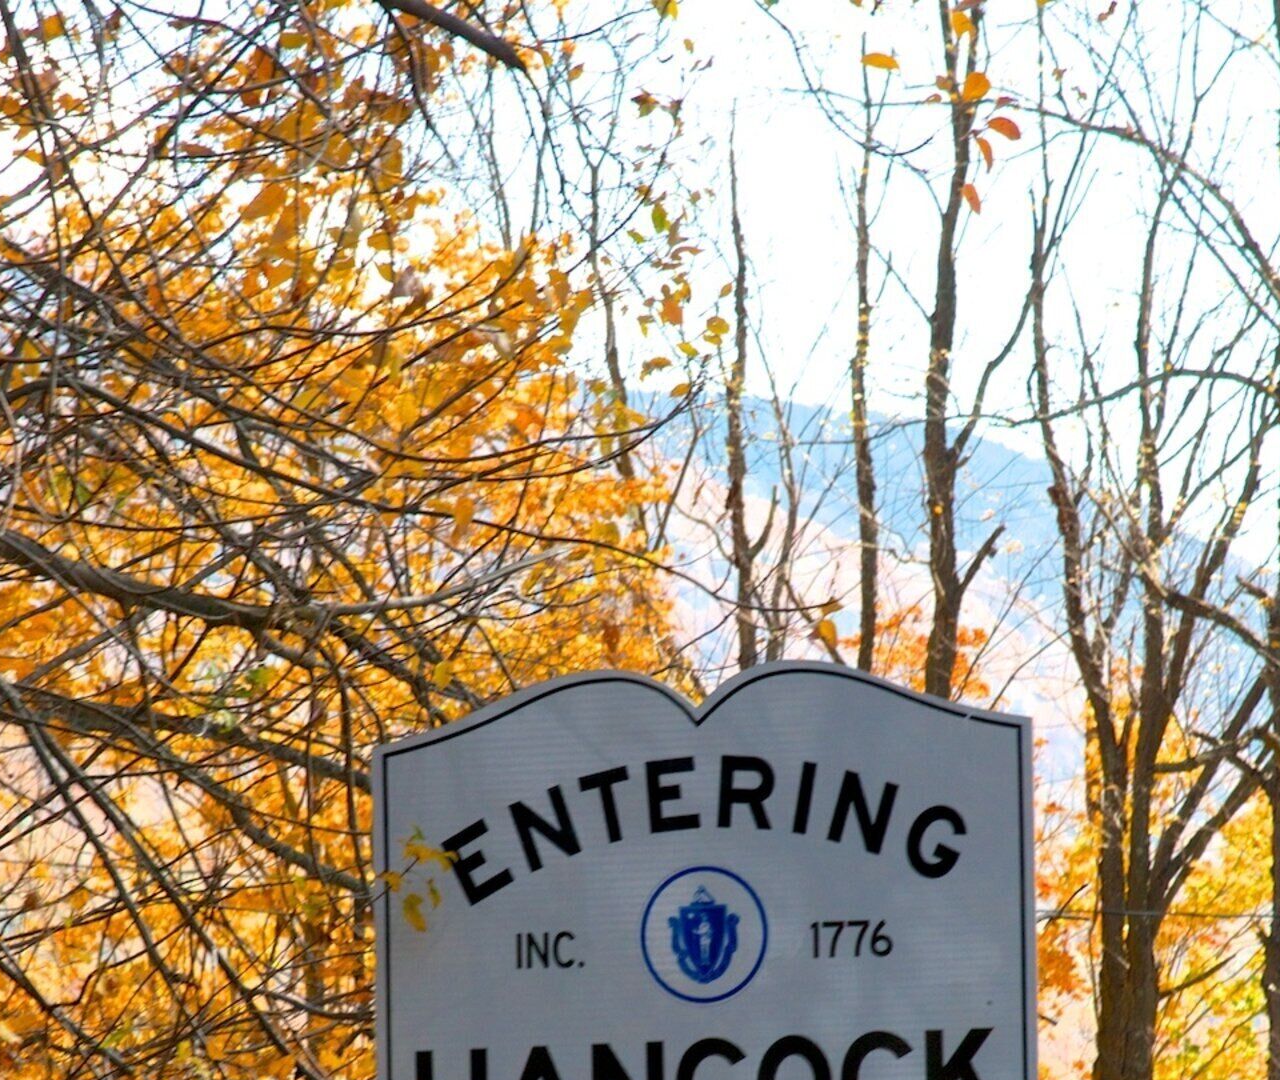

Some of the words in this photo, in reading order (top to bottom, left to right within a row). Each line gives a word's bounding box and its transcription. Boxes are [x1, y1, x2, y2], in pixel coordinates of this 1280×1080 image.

[439, 754, 969, 908] ENTERING
[516, 930, 586, 970] INC.
[809, 919, 895, 959] 1776
